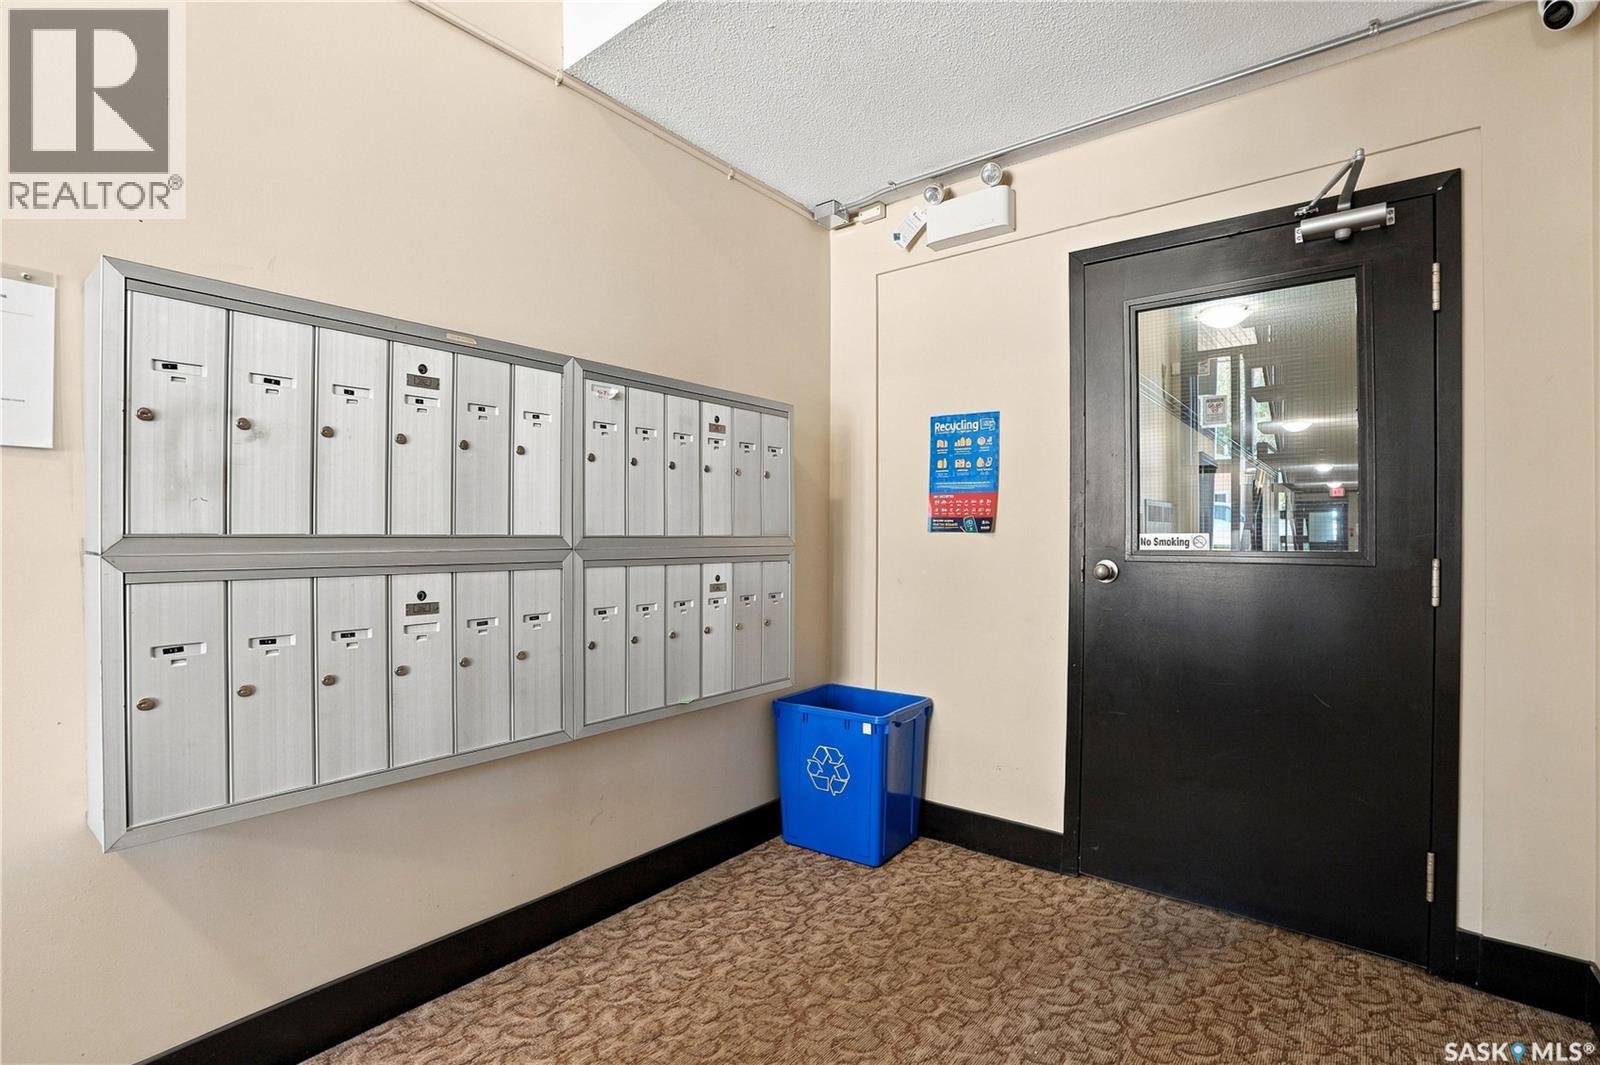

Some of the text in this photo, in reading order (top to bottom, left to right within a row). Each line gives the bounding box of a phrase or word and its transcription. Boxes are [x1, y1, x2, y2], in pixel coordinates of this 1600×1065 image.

[935, 419, 979, 433] Recycling
[1140, 536, 1190, 549] No Smoking
